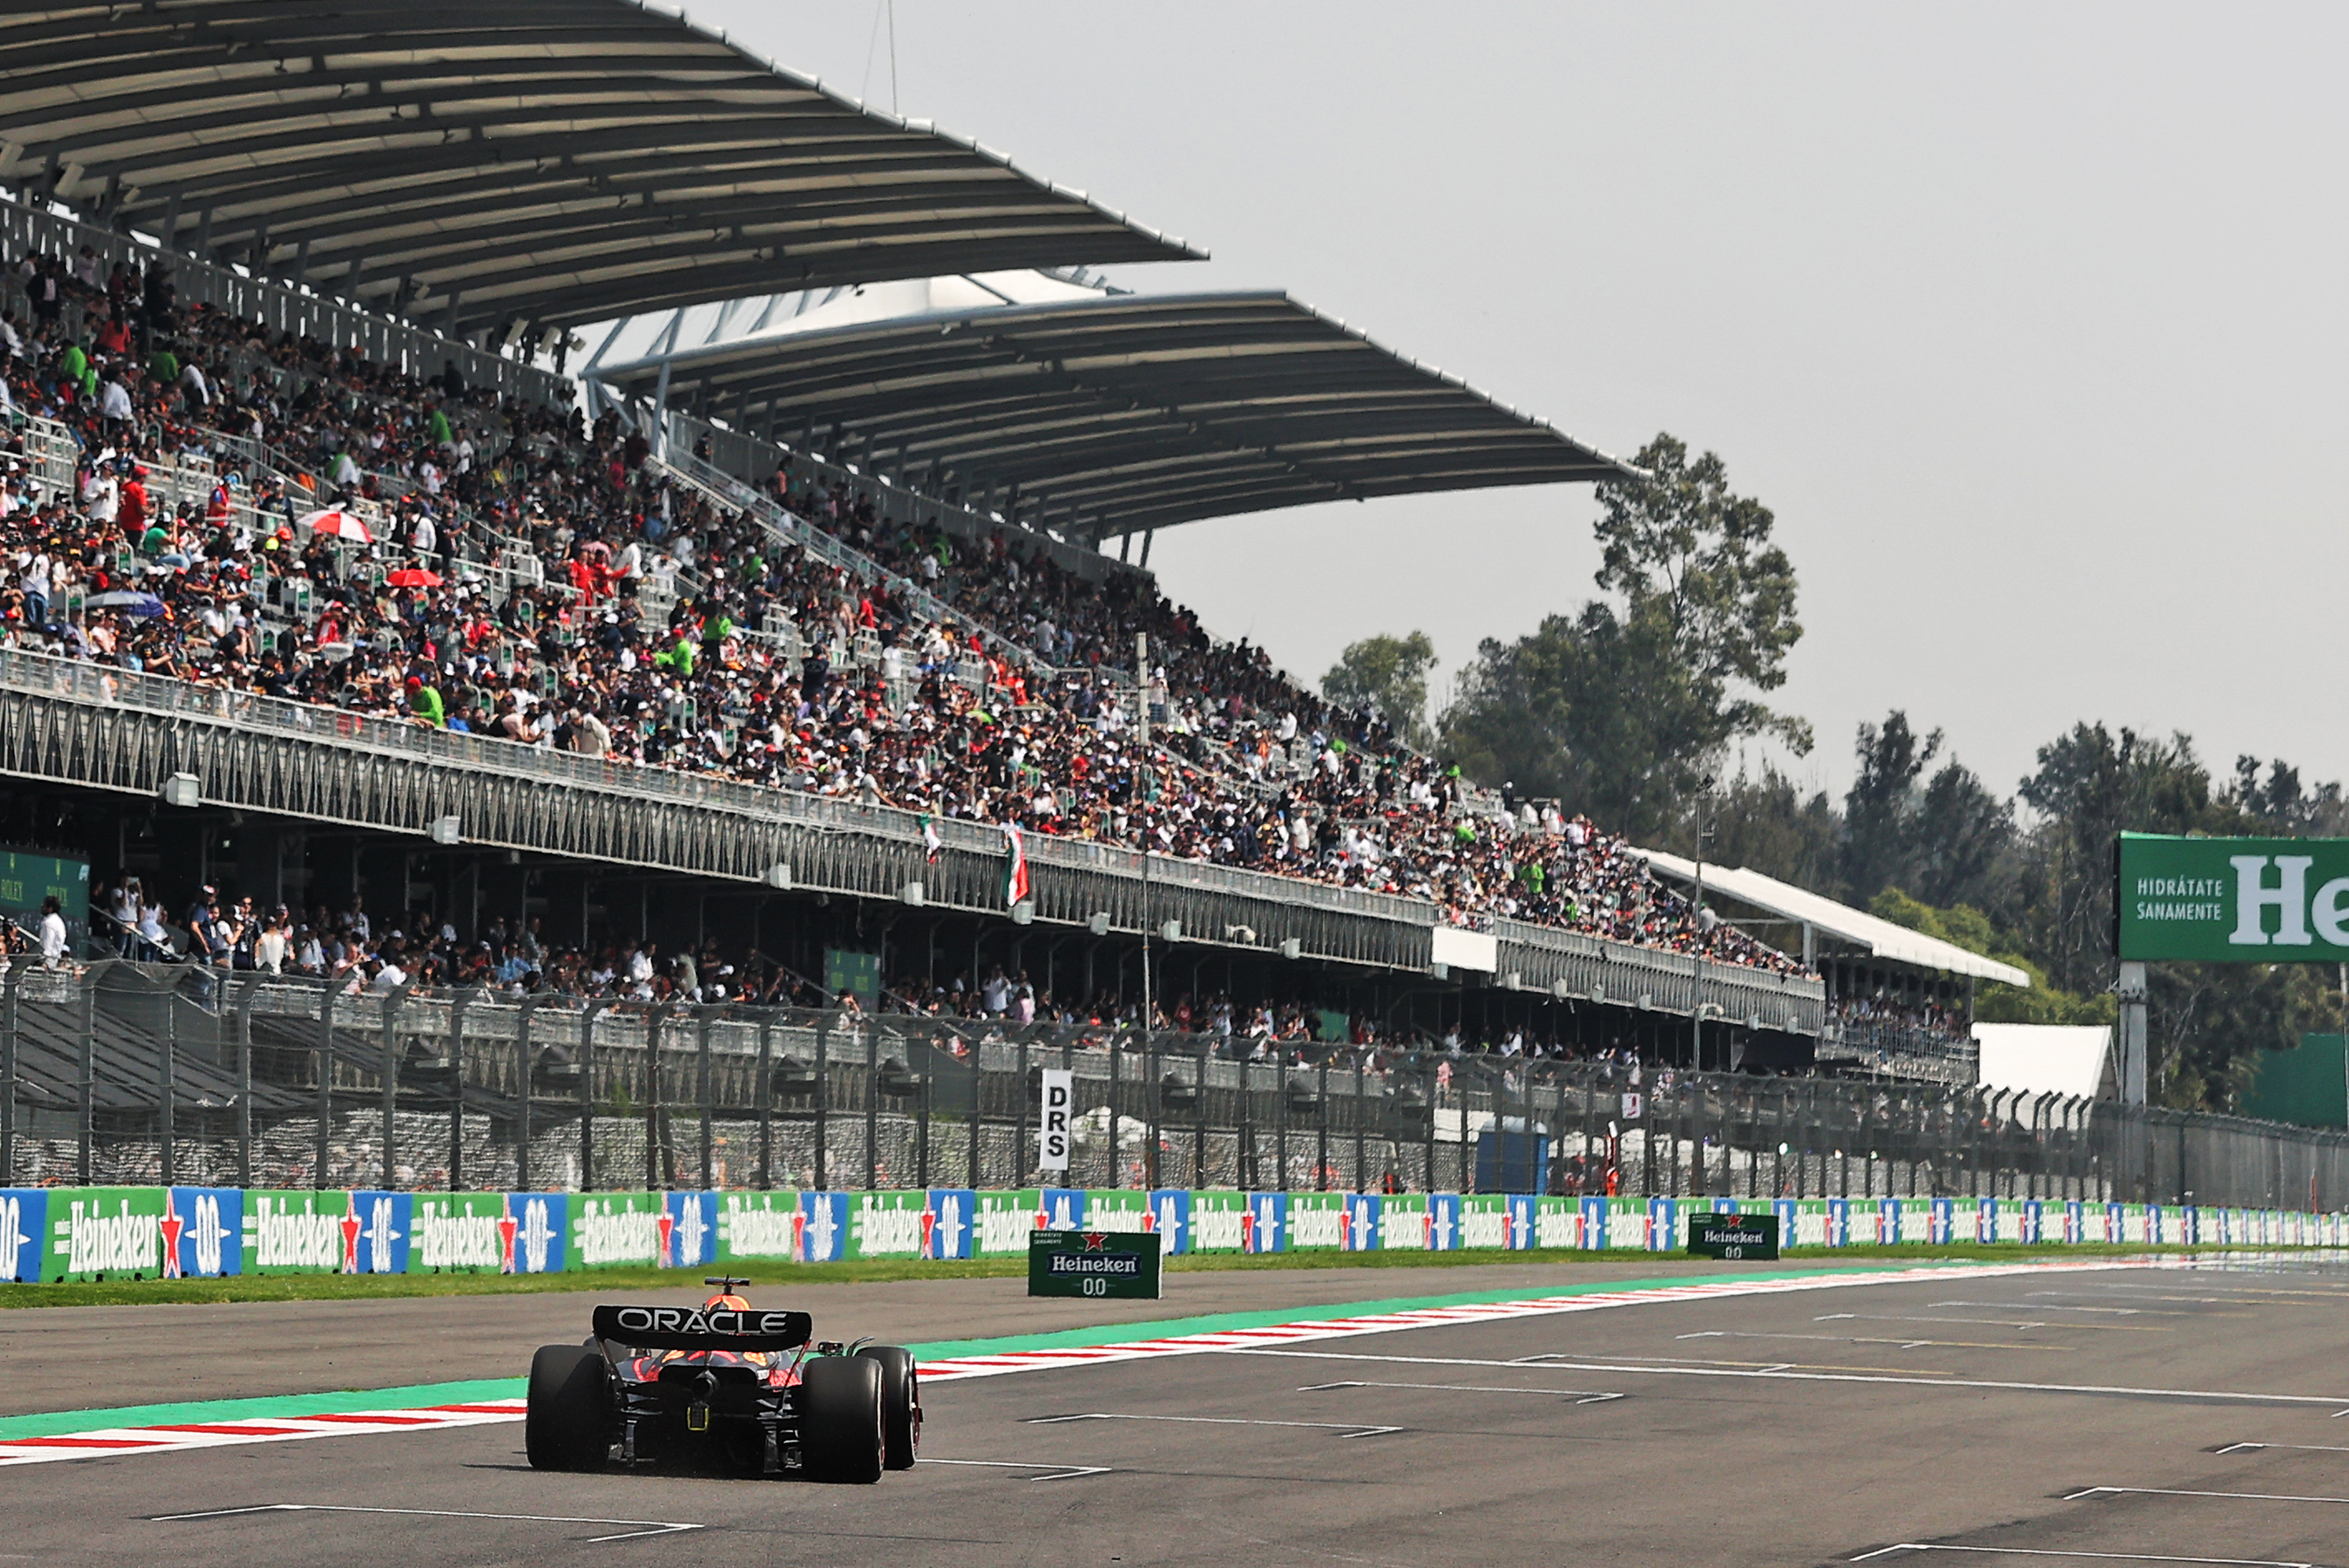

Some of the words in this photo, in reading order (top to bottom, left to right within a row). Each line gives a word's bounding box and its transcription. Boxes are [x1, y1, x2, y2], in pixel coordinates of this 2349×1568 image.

[2137, 874, 2223, 897] HIDRÁTATE
[2137, 902, 2222, 921] SANAMENTE
[1048, 1086, 1066, 1157] DRS
[69, 1199, 158, 1273] Heineken
[256, 1197, 339, 1267] Heineken
[421, 1200, 499, 1266] Heineken
[1704, 1230, 1764, 1244] Heineken
[1052, 1255, 1136, 1273] Heineken
[617, 1308, 788, 1334] ORACLE
